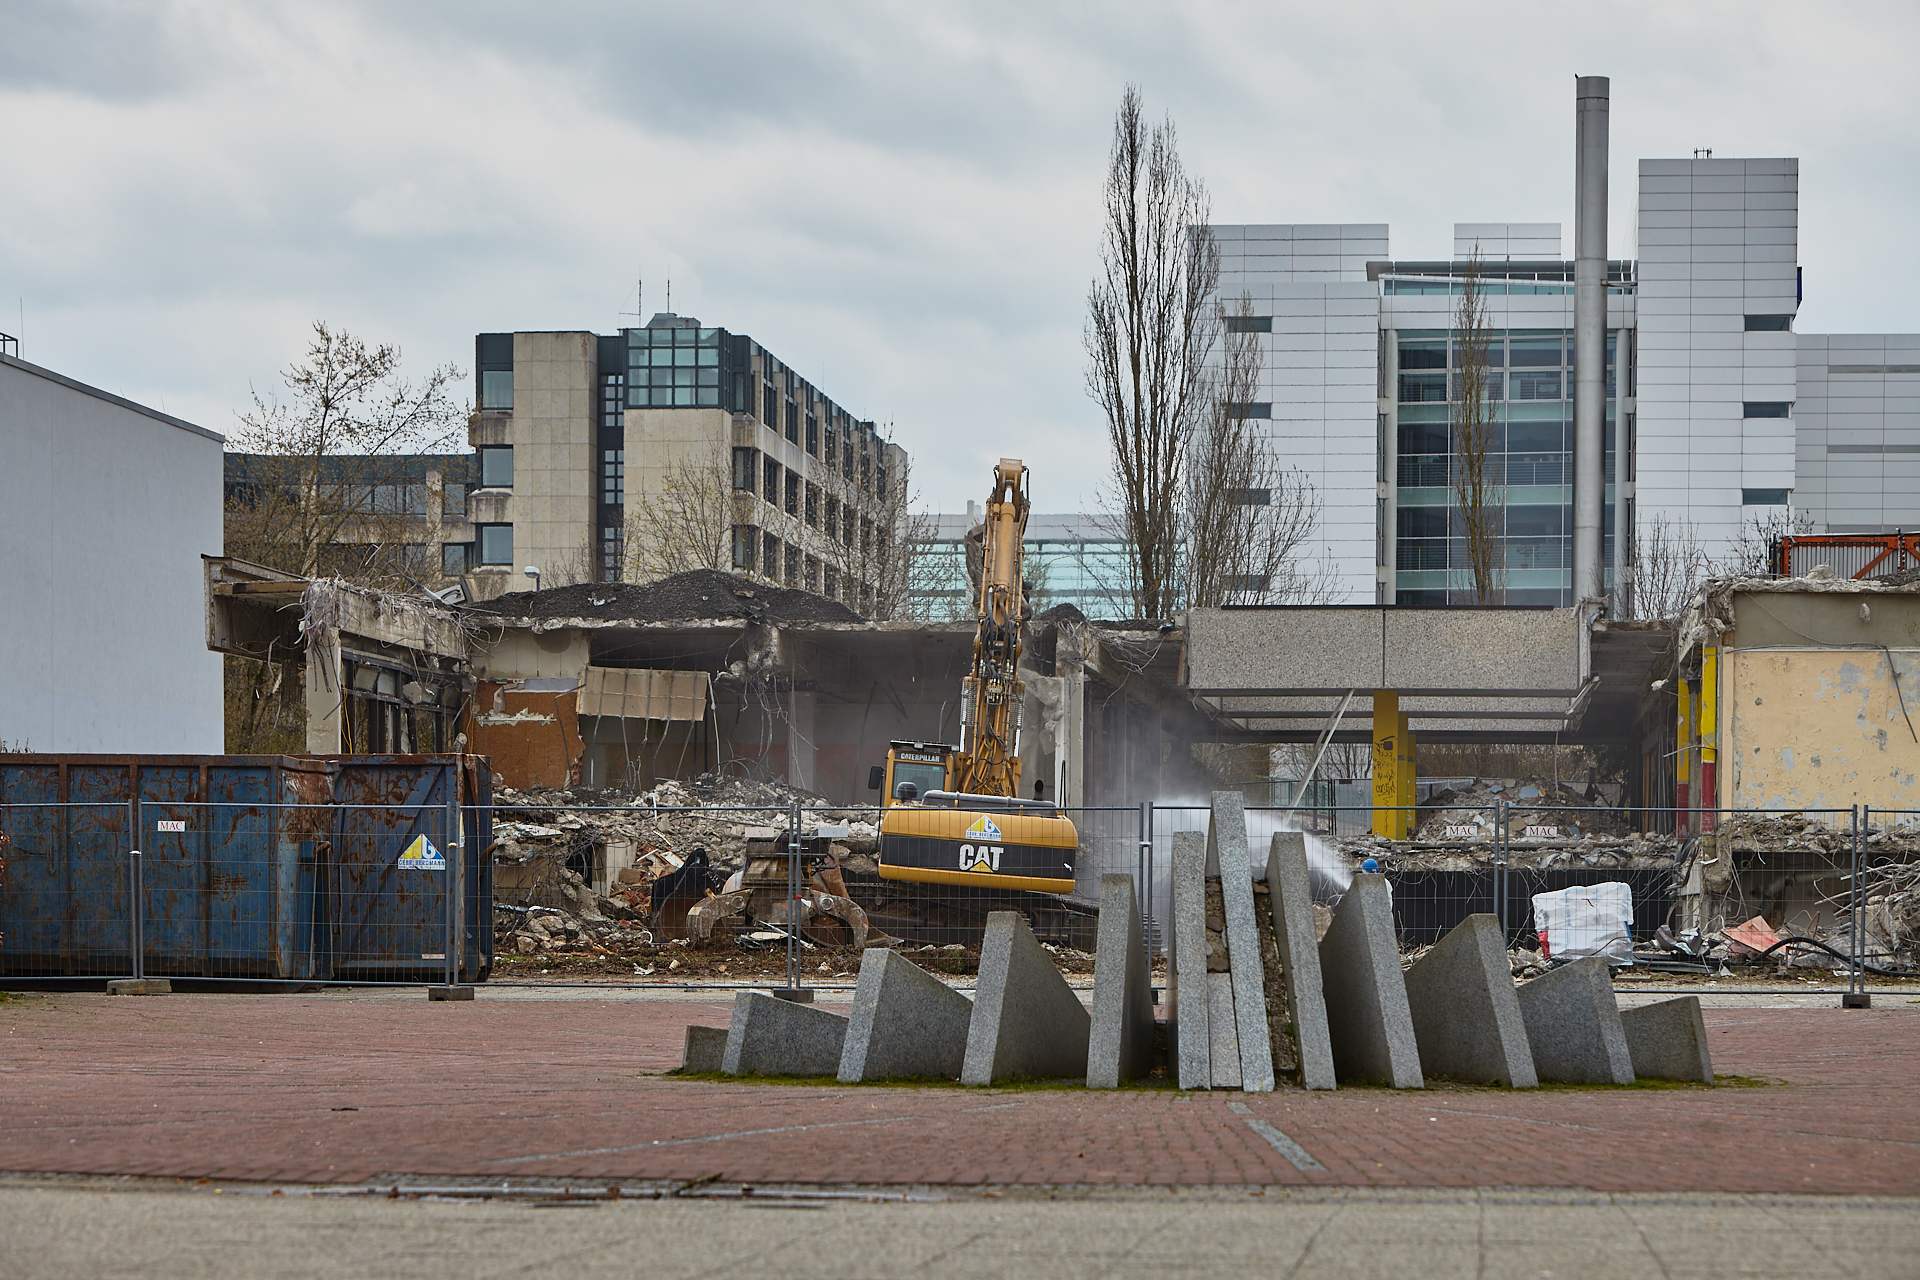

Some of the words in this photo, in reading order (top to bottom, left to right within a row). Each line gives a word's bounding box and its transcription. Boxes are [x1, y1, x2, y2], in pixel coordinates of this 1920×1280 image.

[901, 753, 940, 763] CATERPILLAR
[160, 821, 183, 830] MAC
[1449, 826, 1476, 835] MAC
[1529, 826, 1555, 836] MAC
[959, 844, 1004, 871] CAT
